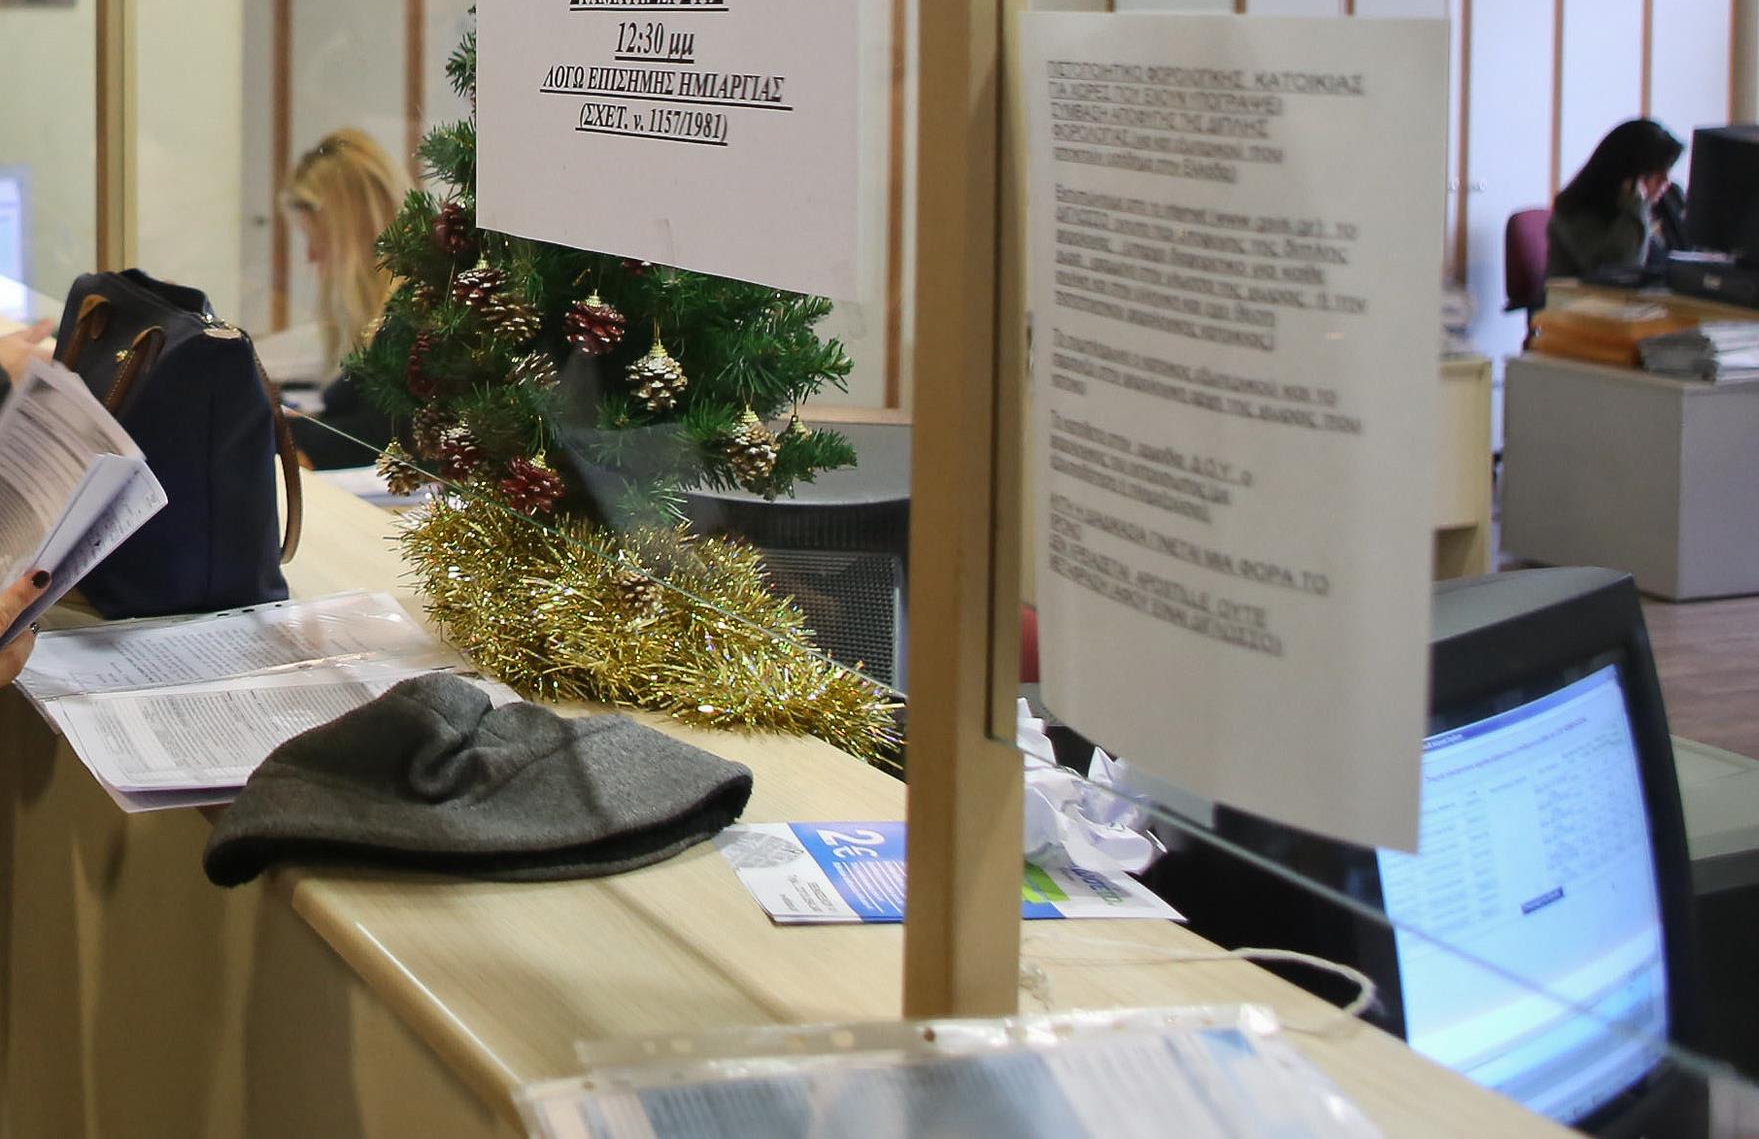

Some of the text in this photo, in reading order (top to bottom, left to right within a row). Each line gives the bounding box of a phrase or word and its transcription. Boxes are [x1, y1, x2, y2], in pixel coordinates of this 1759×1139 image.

[615, 22, 695, 60] 12:30 μμ
[543, 65, 785, 103] ΛΟΓΩ ΕΠΙΣΗΜΗΣ ΗΜΙΑΡΓΙΑΣ
[579, 102, 628, 129] (ΣΧΕΤ.
[649, 108, 728, 142] 1157/1981)
